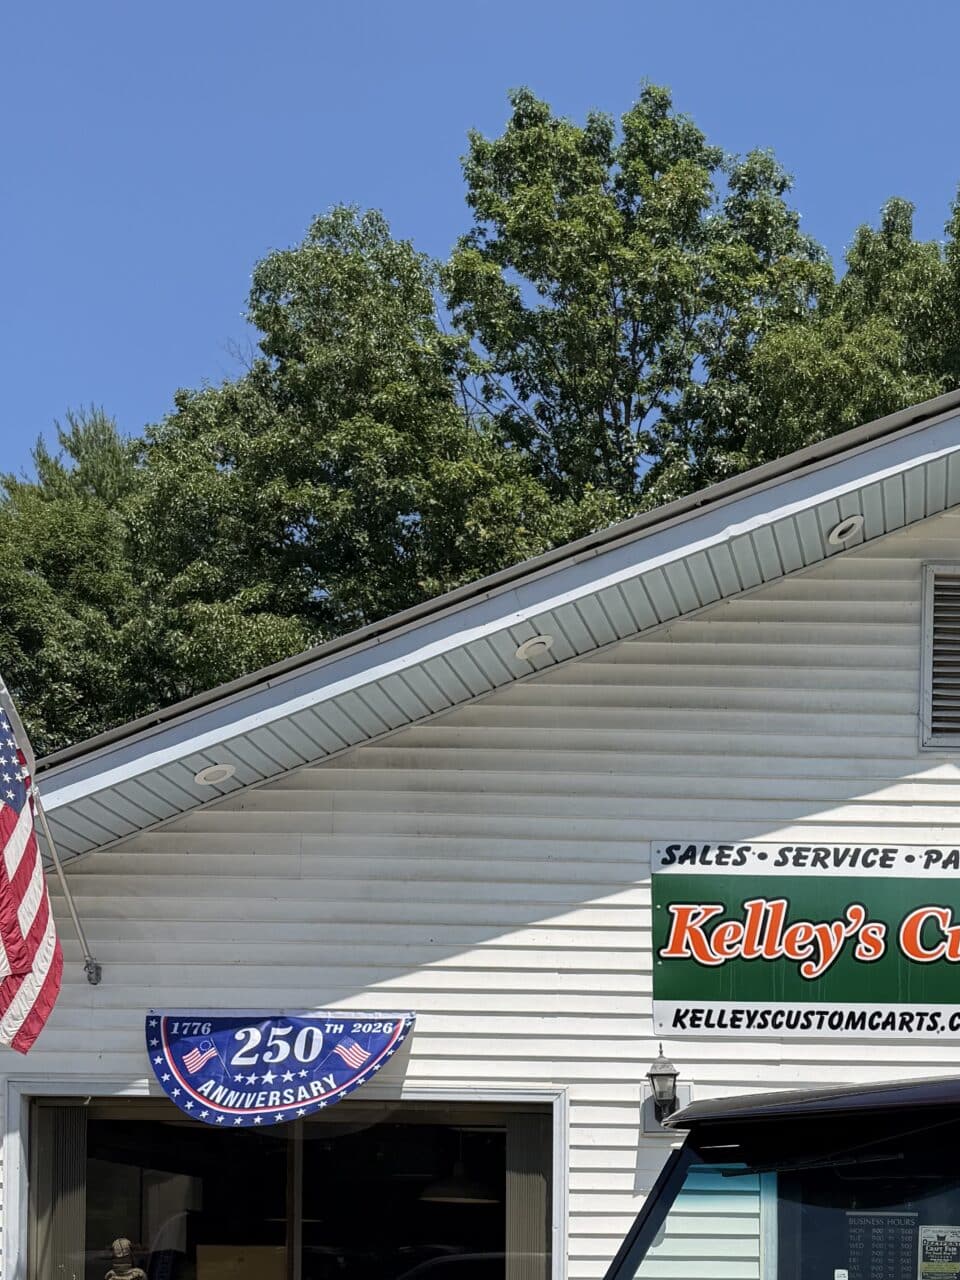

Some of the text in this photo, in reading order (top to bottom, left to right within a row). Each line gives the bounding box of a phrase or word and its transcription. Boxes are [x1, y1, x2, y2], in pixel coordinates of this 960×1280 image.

[661, 844, 752, 866] SALES
[774, 846, 899, 869] SERVICE
[660, 898, 887, 980] Kelley's
[170, 1022, 212, 1036] 1776
[351, 1022, 393, 1034] 2026
[197, 1073, 338, 1109] ANNIVERSARY
[848, 1217, 915, 1226] BUSINESS HOURS
